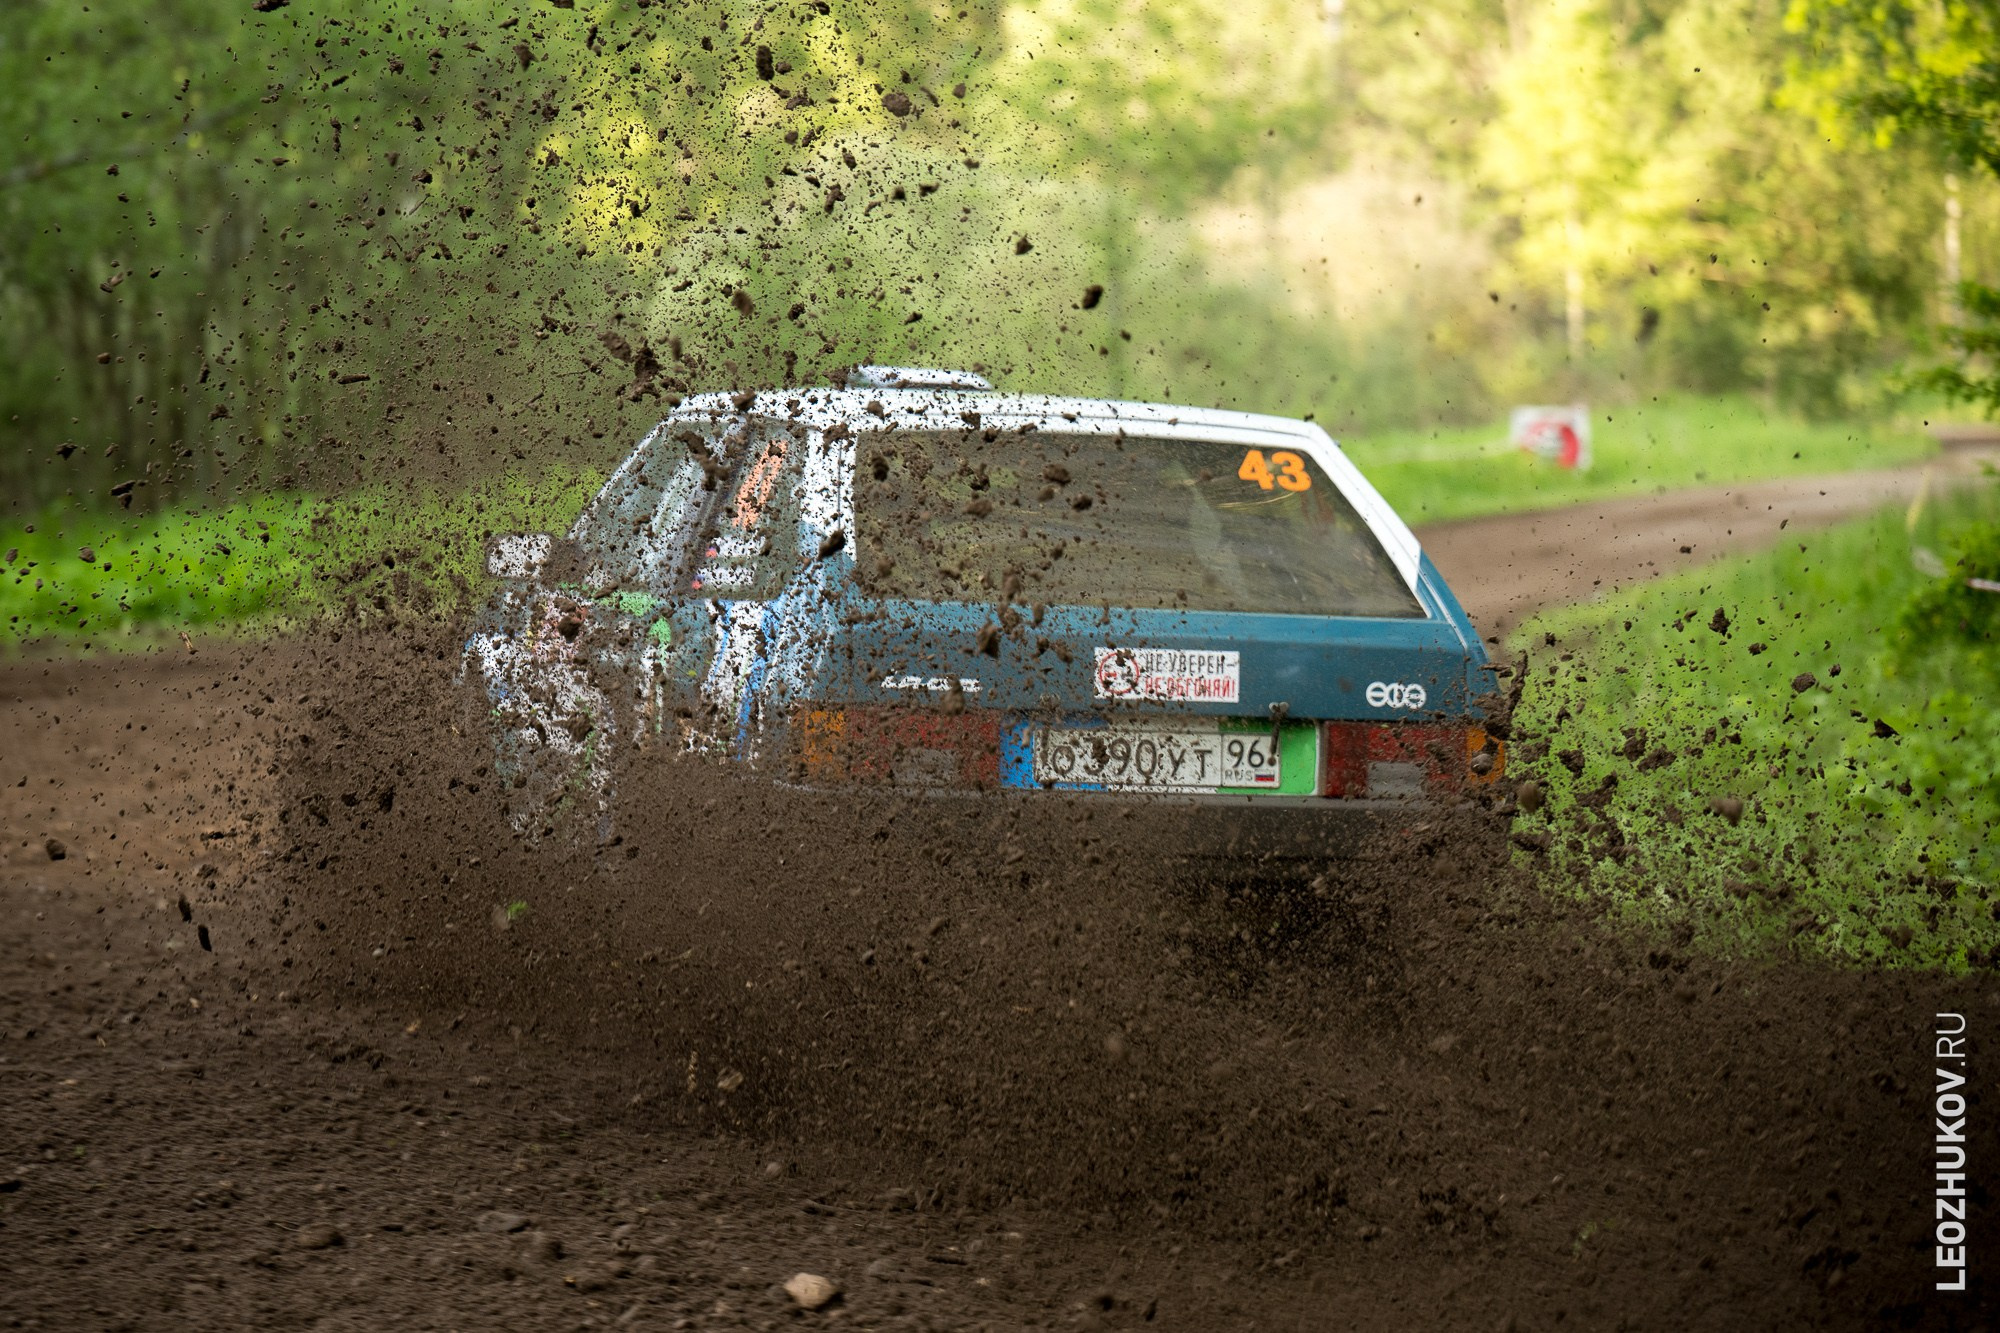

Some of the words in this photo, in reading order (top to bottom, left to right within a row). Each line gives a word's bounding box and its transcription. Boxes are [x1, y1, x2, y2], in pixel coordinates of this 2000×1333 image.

[1238, 449, 1312, 492] 43
[1145, 654, 1164, 673] НЕ
[1145, 677, 1163, 696] НЕ
[1167, 676, 1236, 698] ОБГОНЯЙ!
[1228, 740, 1264, 767] 96
[1225, 769, 1253, 781] RUS
